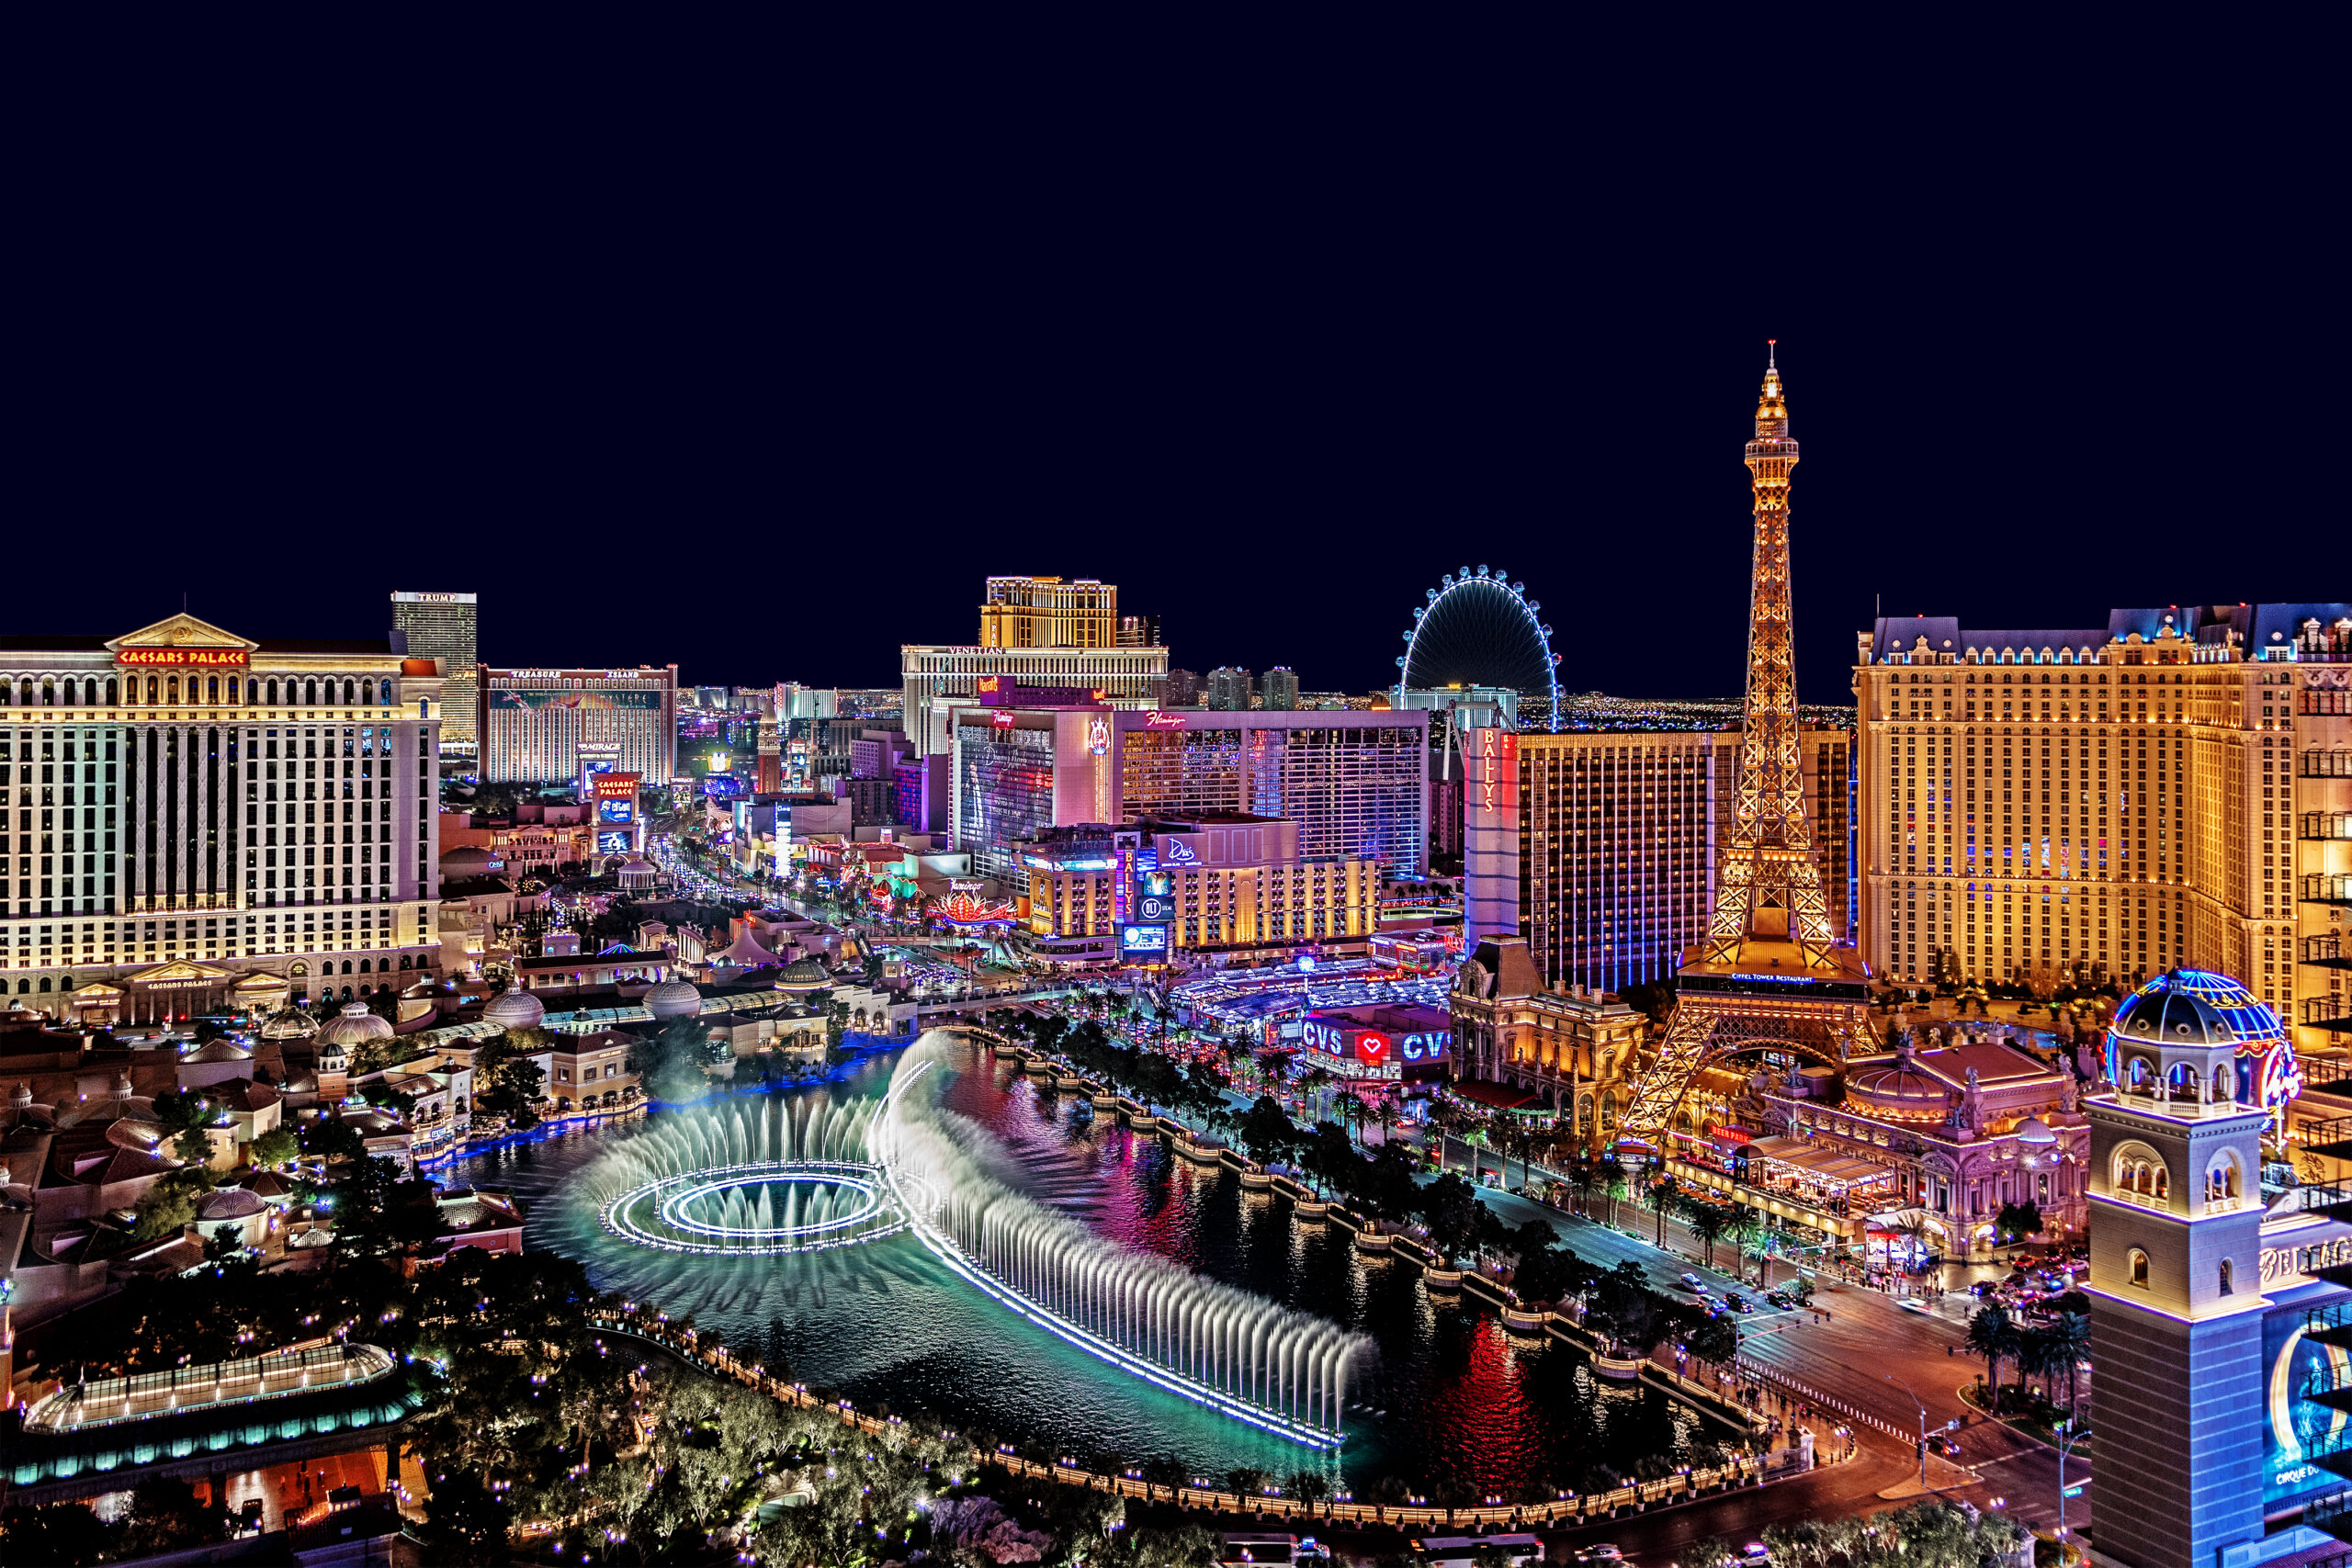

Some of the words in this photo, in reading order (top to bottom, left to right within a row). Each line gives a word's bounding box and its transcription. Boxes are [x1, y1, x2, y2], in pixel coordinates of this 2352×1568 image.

[418, 593, 456, 603] TRUMP
[119, 651, 185, 663] CAESARS
[189, 652, 244, 663] PALACE
[511, 671, 561, 679] TREASURE
[1146, 711, 1185, 728] Flamingo
[588, 743, 621, 751] MIRAGE
[1482, 729, 1496, 813] BALLYS
[1125, 852, 1134, 914] BALLYS
[1146, 903, 1157, 914] BLT
[1303, 1021, 1342, 1055] CVS
[1712, 1126, 1730, 1137] BEER
[1730, 1132, 1748, 1144] PARK
[2276, 1467, 2306, 1484] CIRQUE
